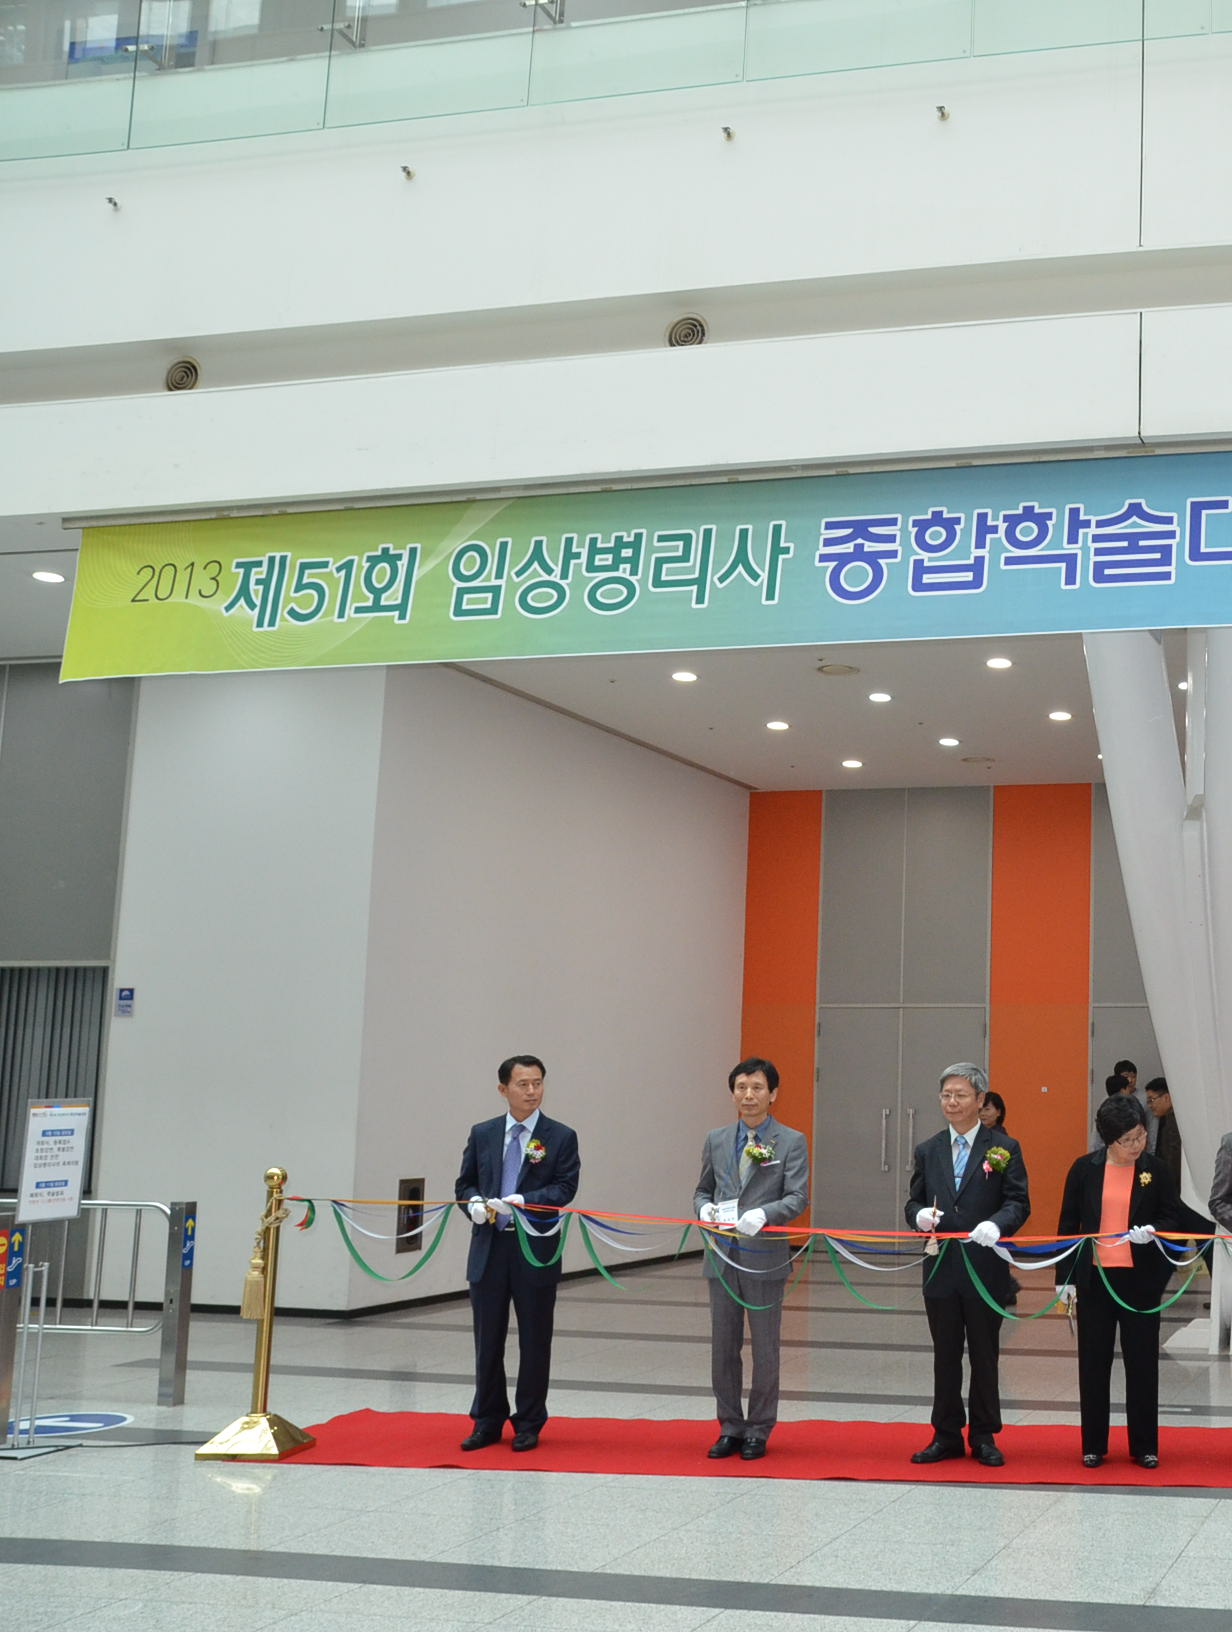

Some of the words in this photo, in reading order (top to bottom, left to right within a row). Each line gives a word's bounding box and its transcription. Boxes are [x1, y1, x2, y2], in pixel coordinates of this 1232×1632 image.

[131, 560, 221, 604] 2013
[224, 543, 421, 629] 제51회
[448, 521, 792, 619] 임상병리사
